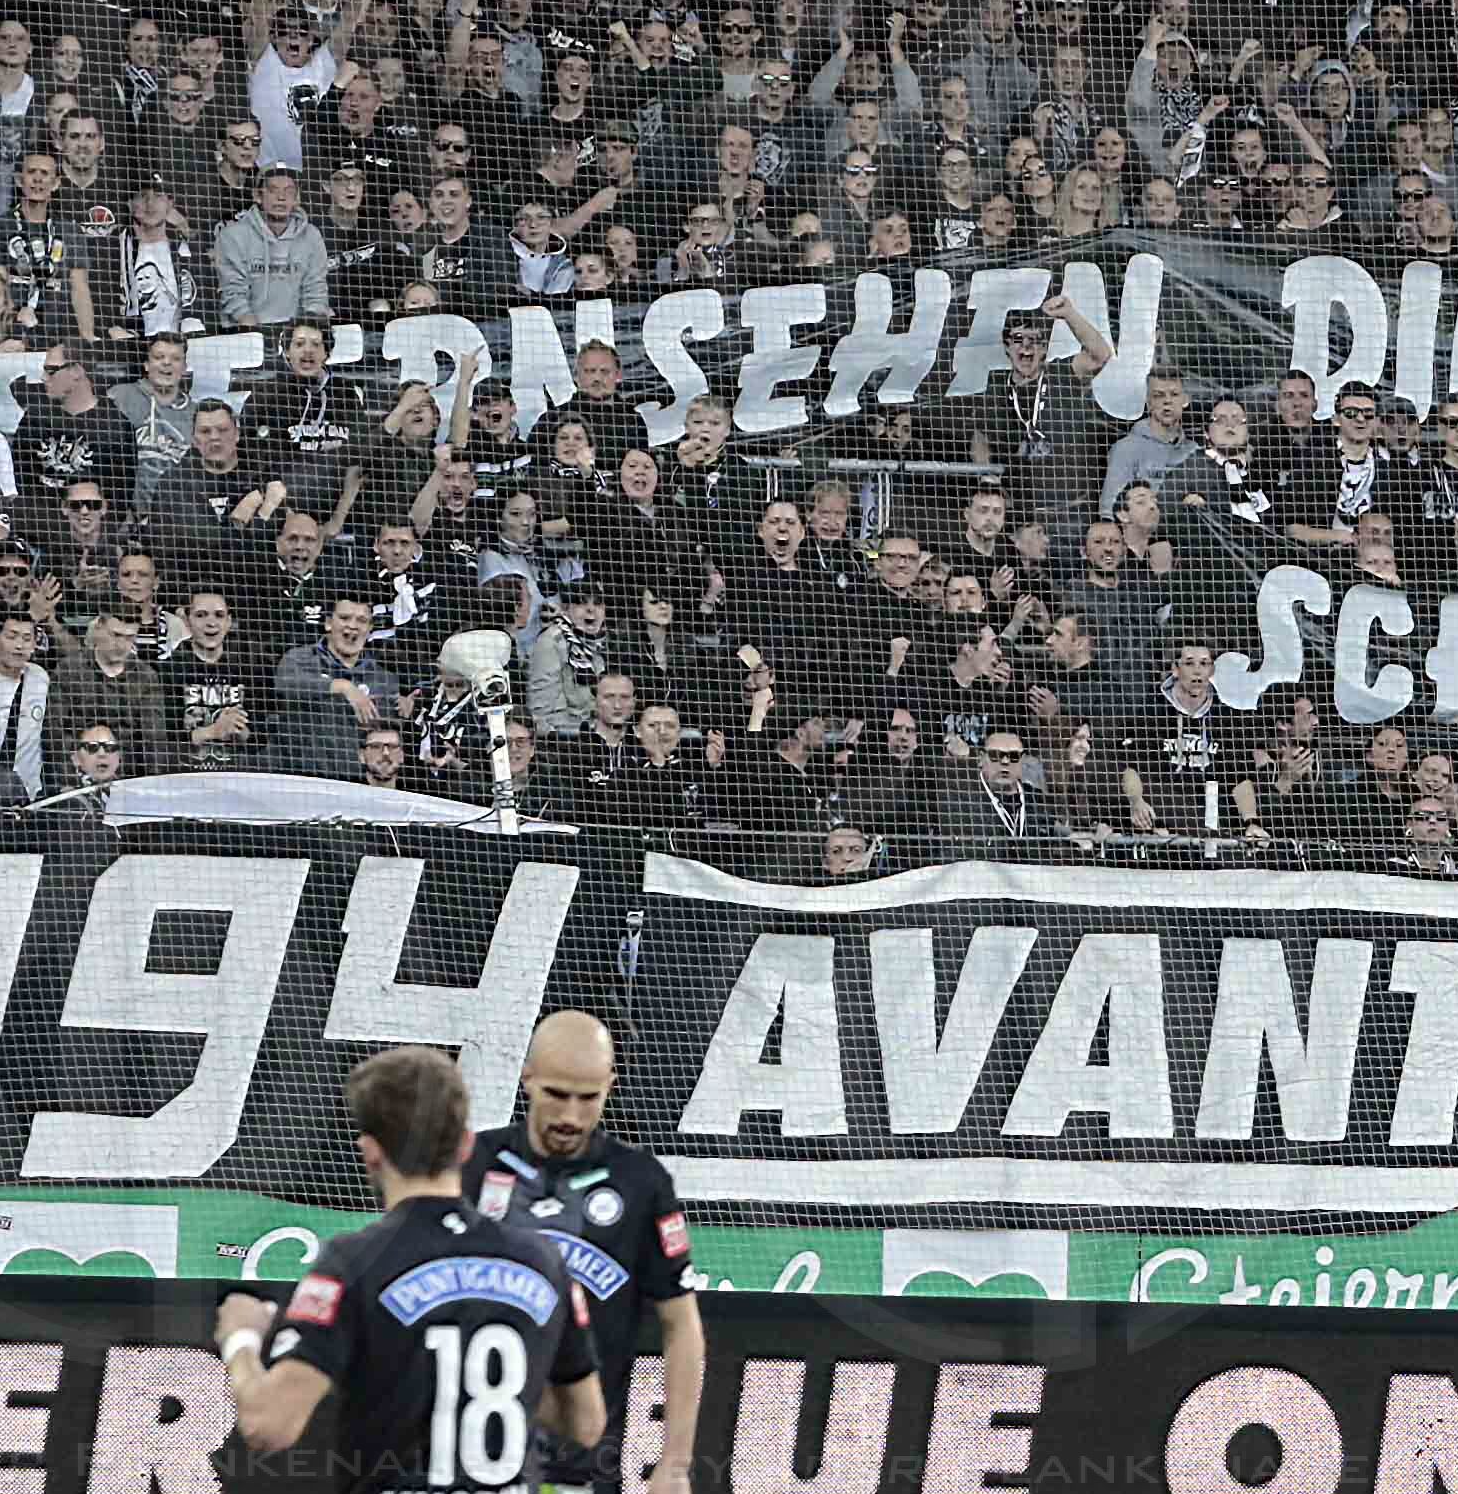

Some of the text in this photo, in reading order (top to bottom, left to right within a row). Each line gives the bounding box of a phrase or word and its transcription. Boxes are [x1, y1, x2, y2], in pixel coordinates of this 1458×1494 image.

[187, 252, 1164, 445] FRNSEHEN
[388, 1262, 558, 1324] PUNTIGAMER
[425, 1323, 529, 1489] 18
